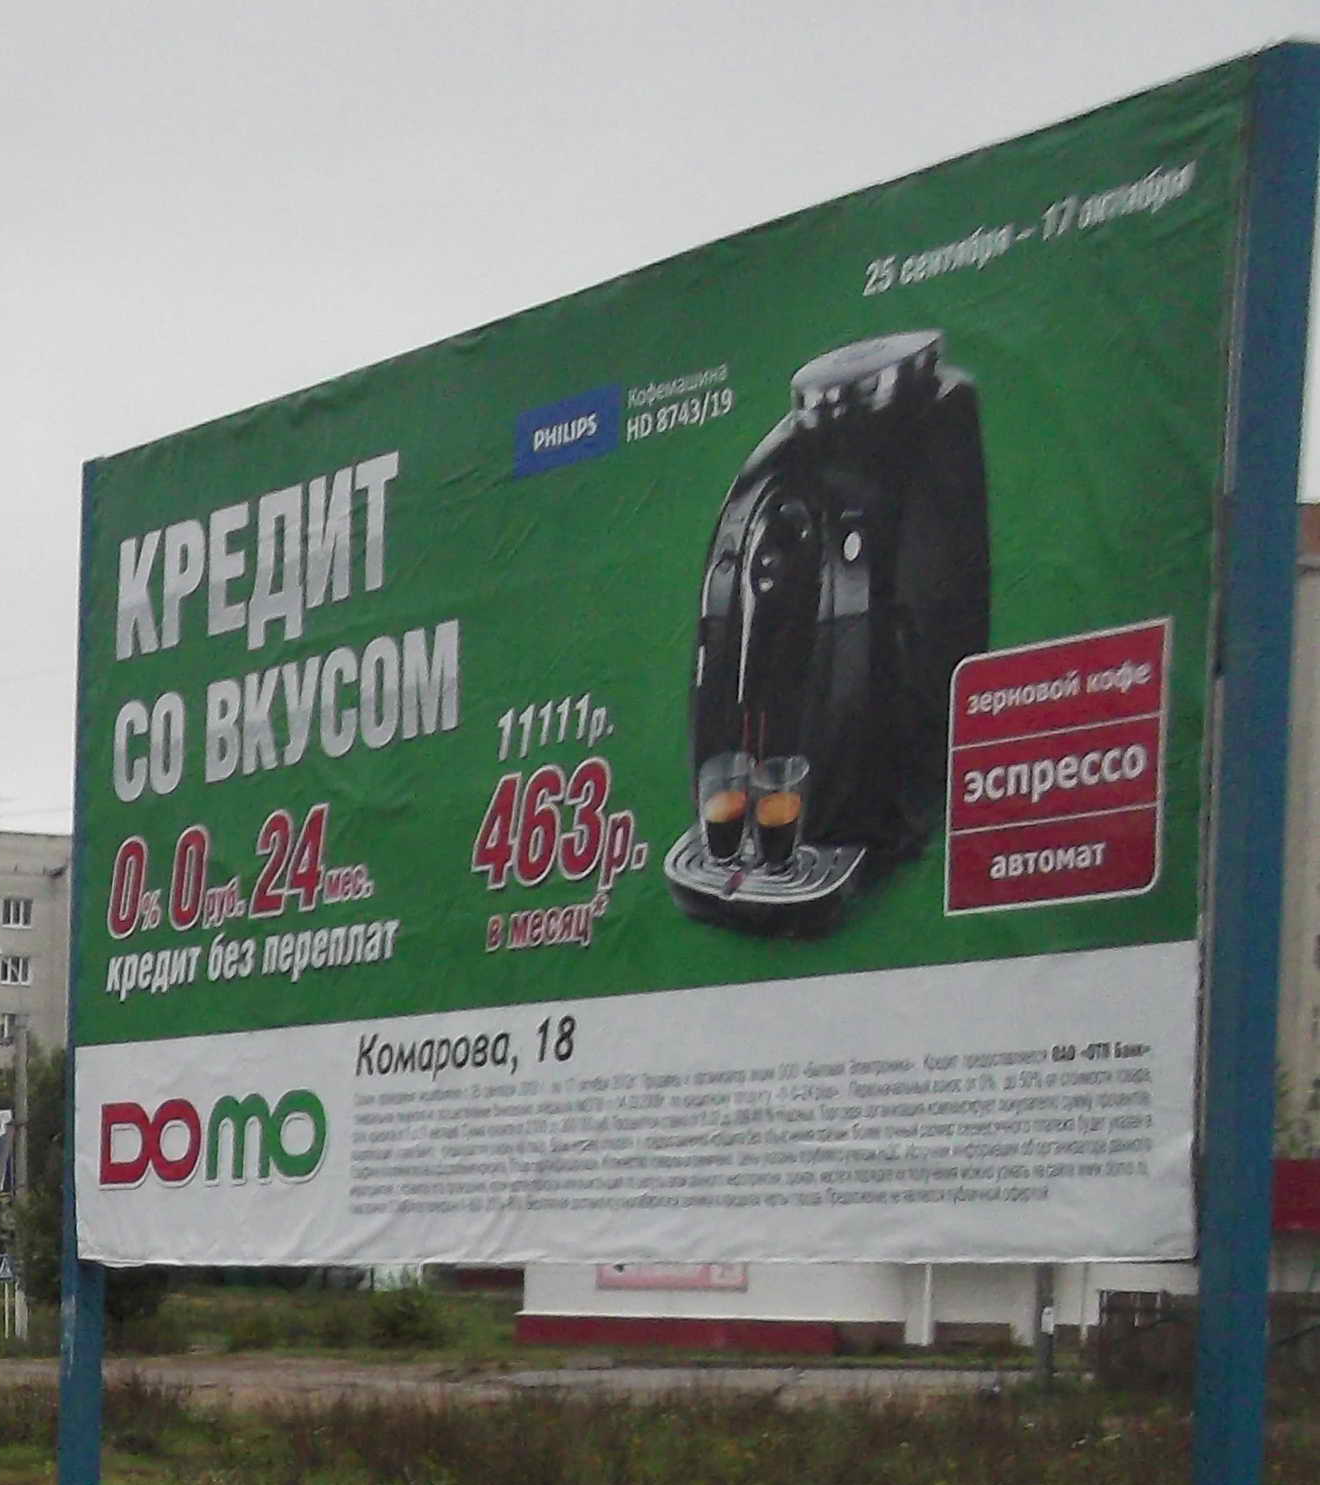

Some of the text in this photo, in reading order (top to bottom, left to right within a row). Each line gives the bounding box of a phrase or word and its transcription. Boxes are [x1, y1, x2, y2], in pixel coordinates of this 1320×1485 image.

[862, 254, 897, 296] 25
[1041, 194, 1079, 242] 17
[626, 387, 734, 443] HD 8743/19
[627, 362, 729, 409] Кофемашина
[533, 412, 599, 452] PHILIPS
[115, 450, 400, 662] КРЕДИТ
[113, 617, 460, 803] СО ВКУСОМ
[966, 660, 1153, 716] зерновой кофе
[498, 692, 616, 762] 11111р.
[963, 743, 1150, 804] эспрессо
[989, 842, 1107, 880] автомат
[106, 918, 401, 1004] кредит без переплат
[485, 913, 505, 953] в
[355, 1030, 519, 1083] Комарова,
[536, 1014, 577, 1064] 18
